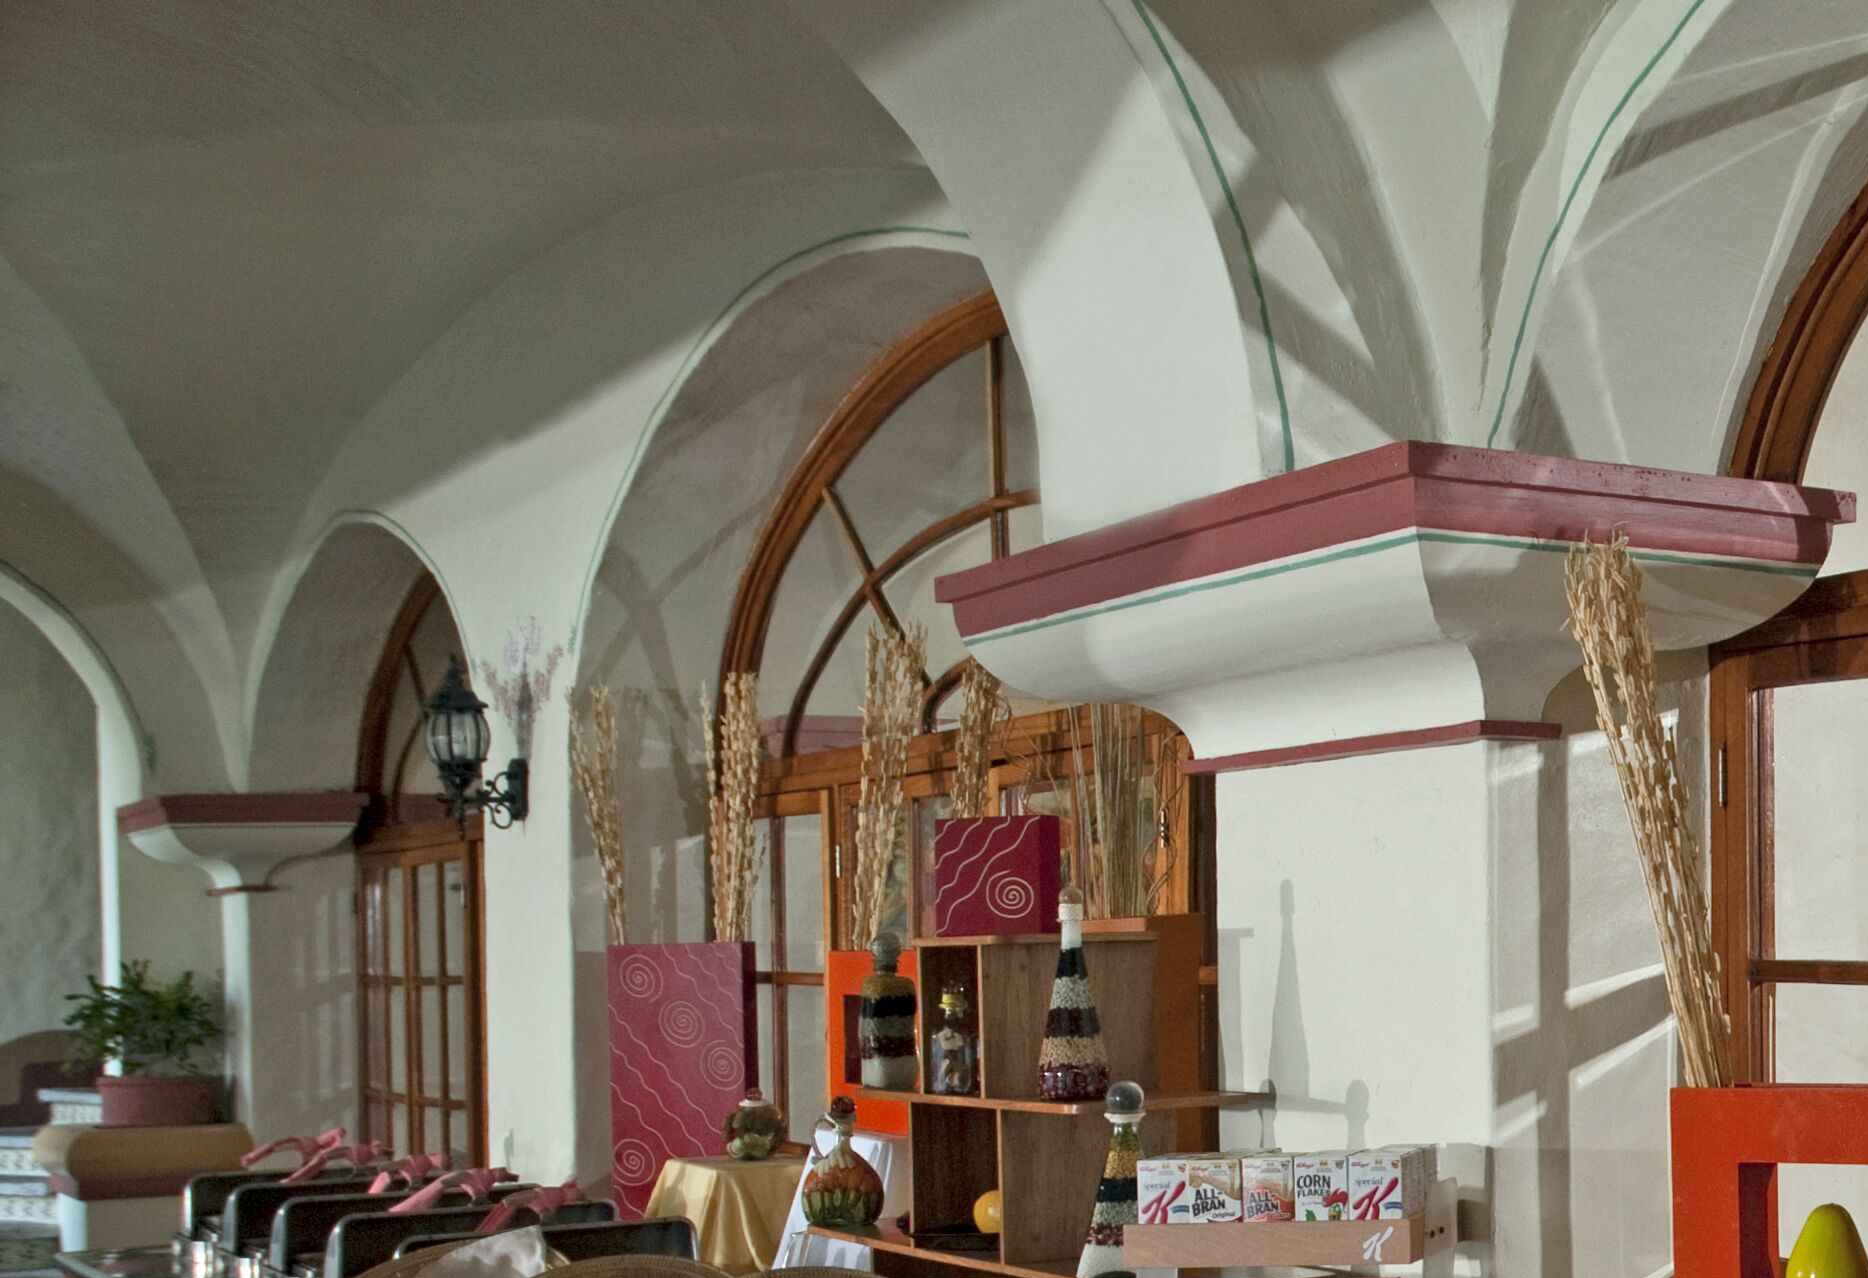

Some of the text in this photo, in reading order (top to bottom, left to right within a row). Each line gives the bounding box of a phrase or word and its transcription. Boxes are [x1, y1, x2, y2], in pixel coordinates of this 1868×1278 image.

[1296, 1174, 1331, 1189] CORN
[1354, 1176, 1383, 1187] special
[1141, 1181, 1186, 1224] K
[1195, 1188, 1223, 1203] ALL-
[1249, 1191, 1275, 1203] ALL-
[1352, 1177, 1399, 1220] K
[1191, 1199, 1226, 1217] BRAN
[1246, 1201, 1279, 1218] BRAN
[1362, 1226, 1394, 1262] K
